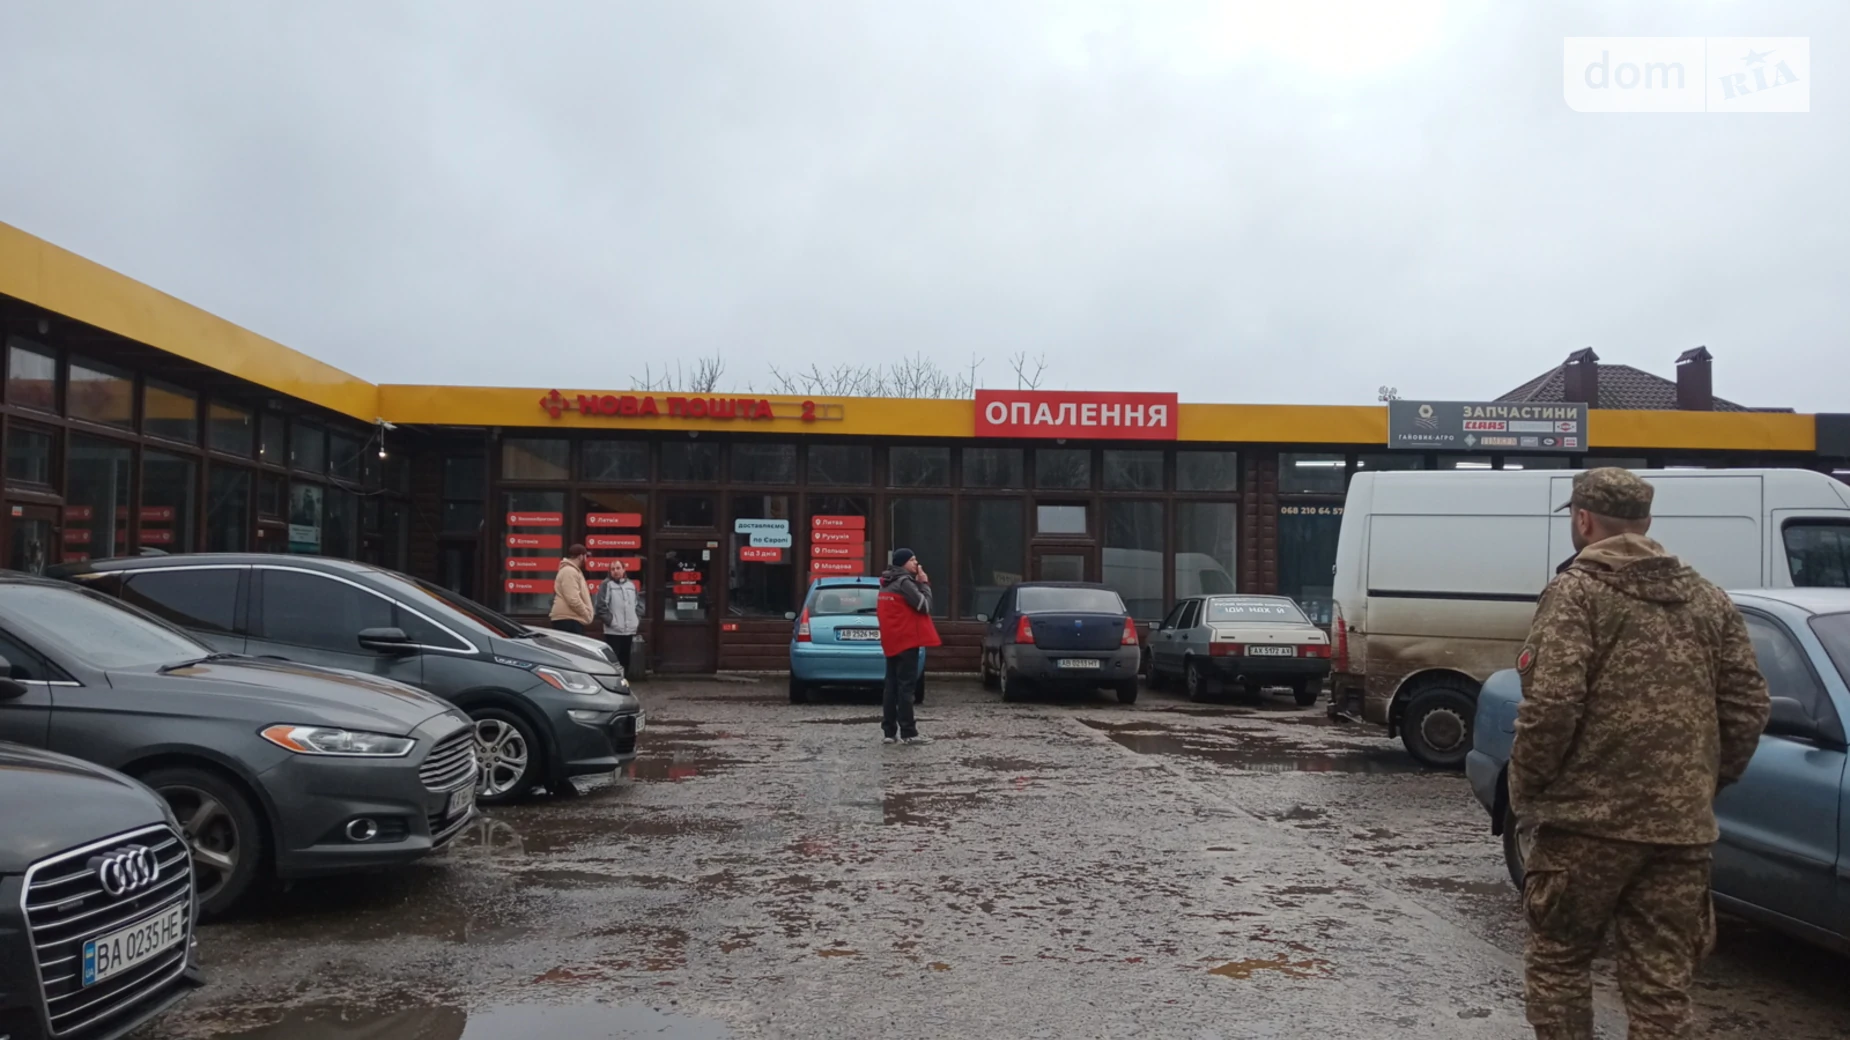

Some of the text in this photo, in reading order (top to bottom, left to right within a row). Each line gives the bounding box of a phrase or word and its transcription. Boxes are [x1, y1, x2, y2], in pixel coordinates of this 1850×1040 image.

[577, 394, 816, 421] НОВА ПОШТА 2
[1463, 406, 1578, 418] ЗАПЧАСТИНИ
[985, 401, 1168, 427] ОПАЛЕННЯ
[1464, 421, 1505, 430] CLAAS
[1281, 507, 1299, 515] 068
[1301, 507, 1316, 515] 210
[1318, 507, 1331, 515] 64
[821, 562, 852, 570] Молдова
[97, 911, 178, 974] BA 0235 HE
